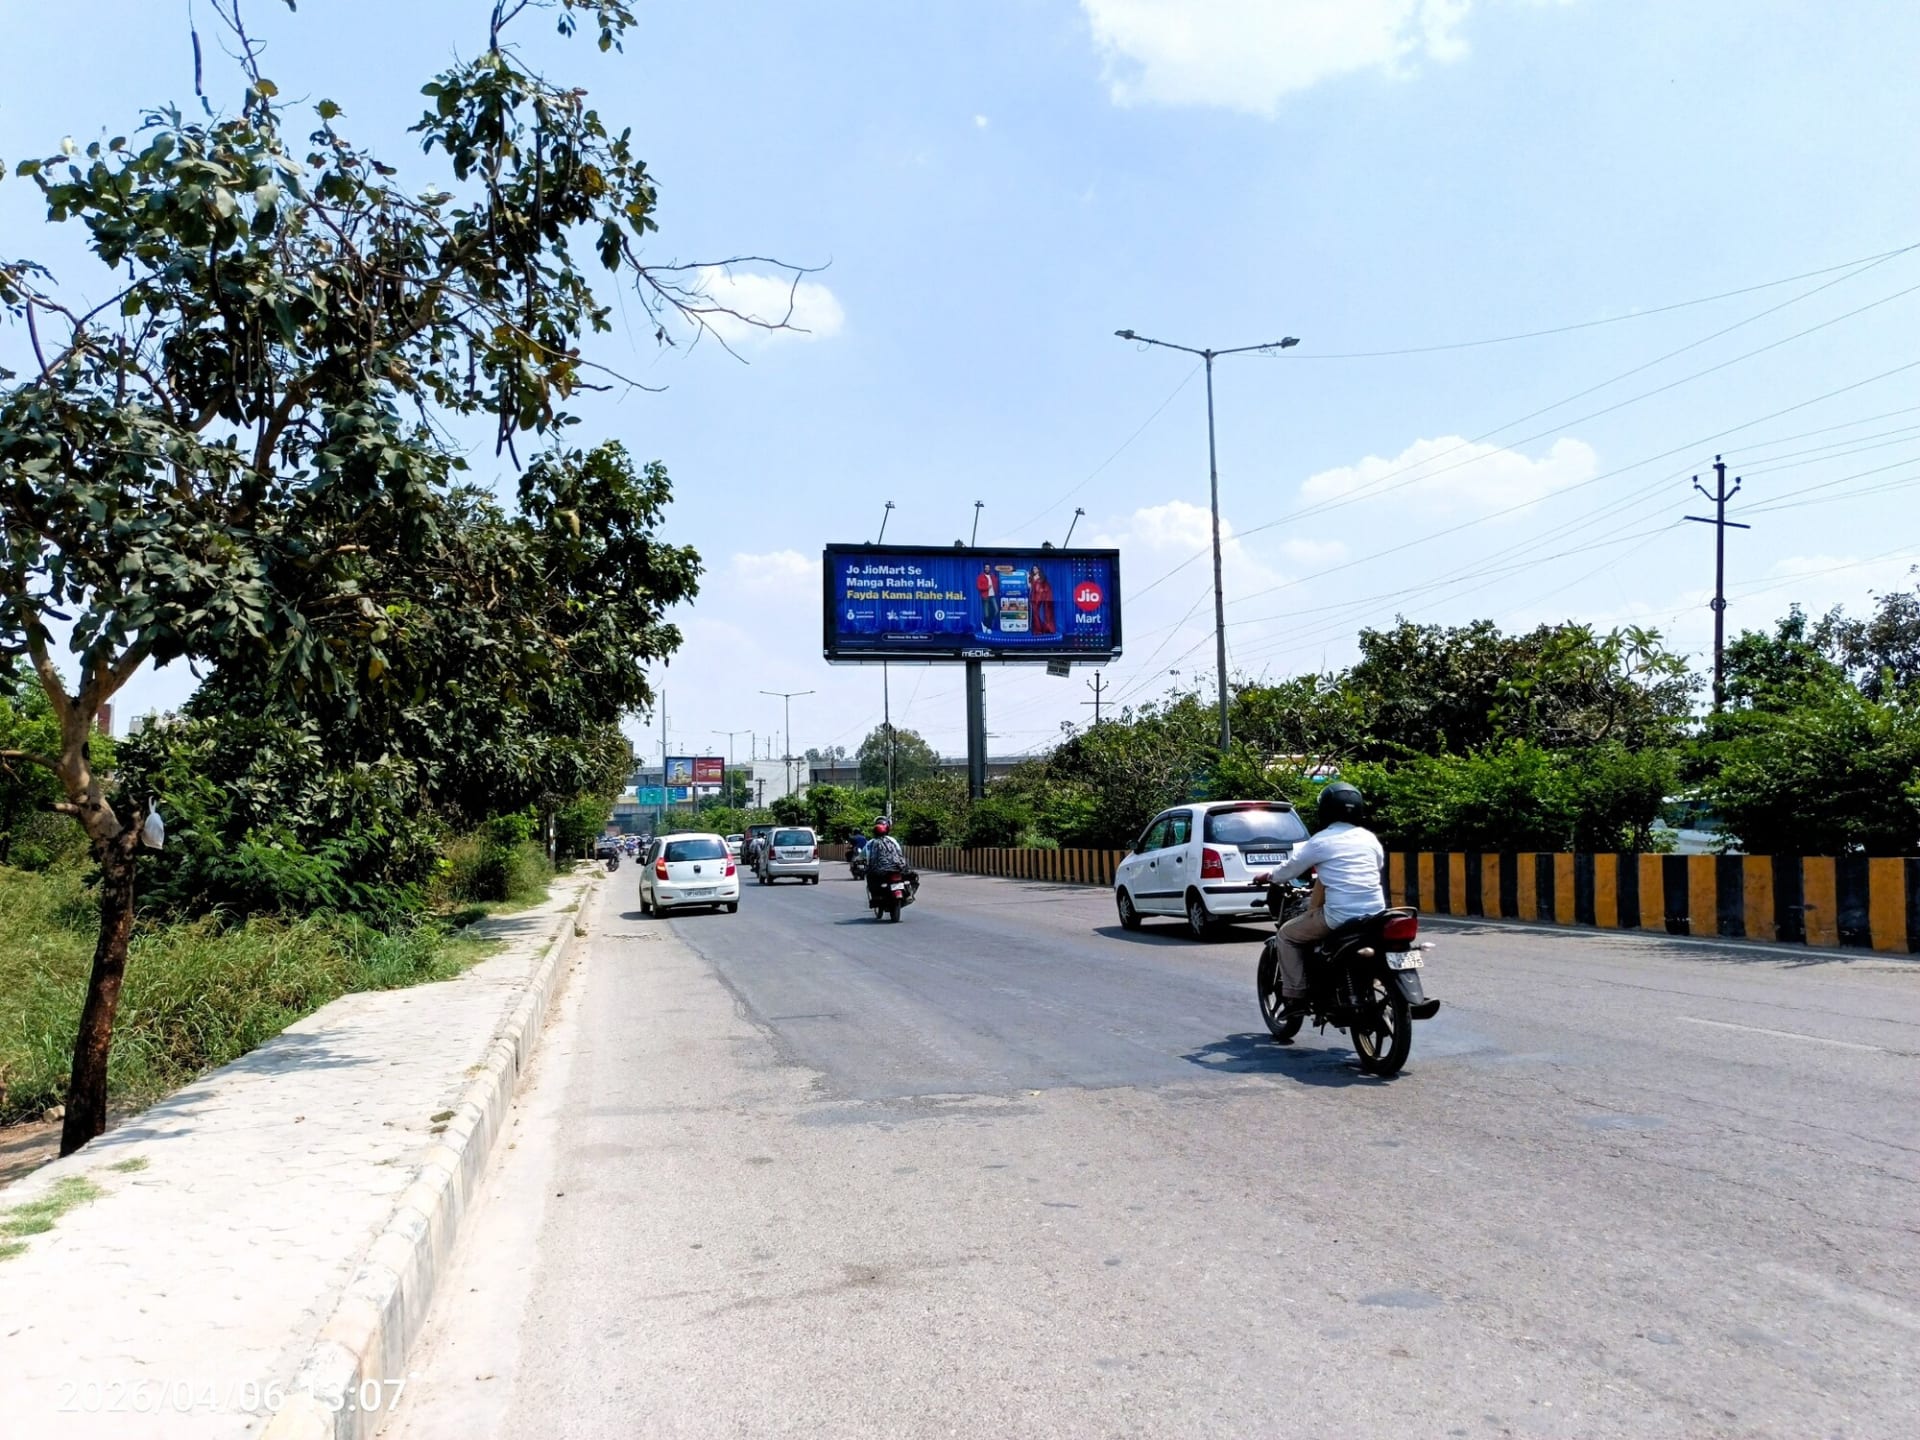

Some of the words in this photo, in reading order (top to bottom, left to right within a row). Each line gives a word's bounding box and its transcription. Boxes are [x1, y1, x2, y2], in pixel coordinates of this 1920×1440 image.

[846, 565, 860, 574] Jo
[862, 565, 905, 575] JioMart
[907, 566, 922, 575] Se
[846, 578, 883, 589] Manga
[886, 578, 914, 588] Rahe
[917, 578, 938, 589] Hai,
[847, 590, 879, 600] Fayda
[882, 591, 913, 600] Kama
[915, 591, 943, 600] Rahe
[945, 591, 967, 600] Hai.
[1077, 589, 1100, 602] Jio
[1075, 614, 1101, 624] Mart
